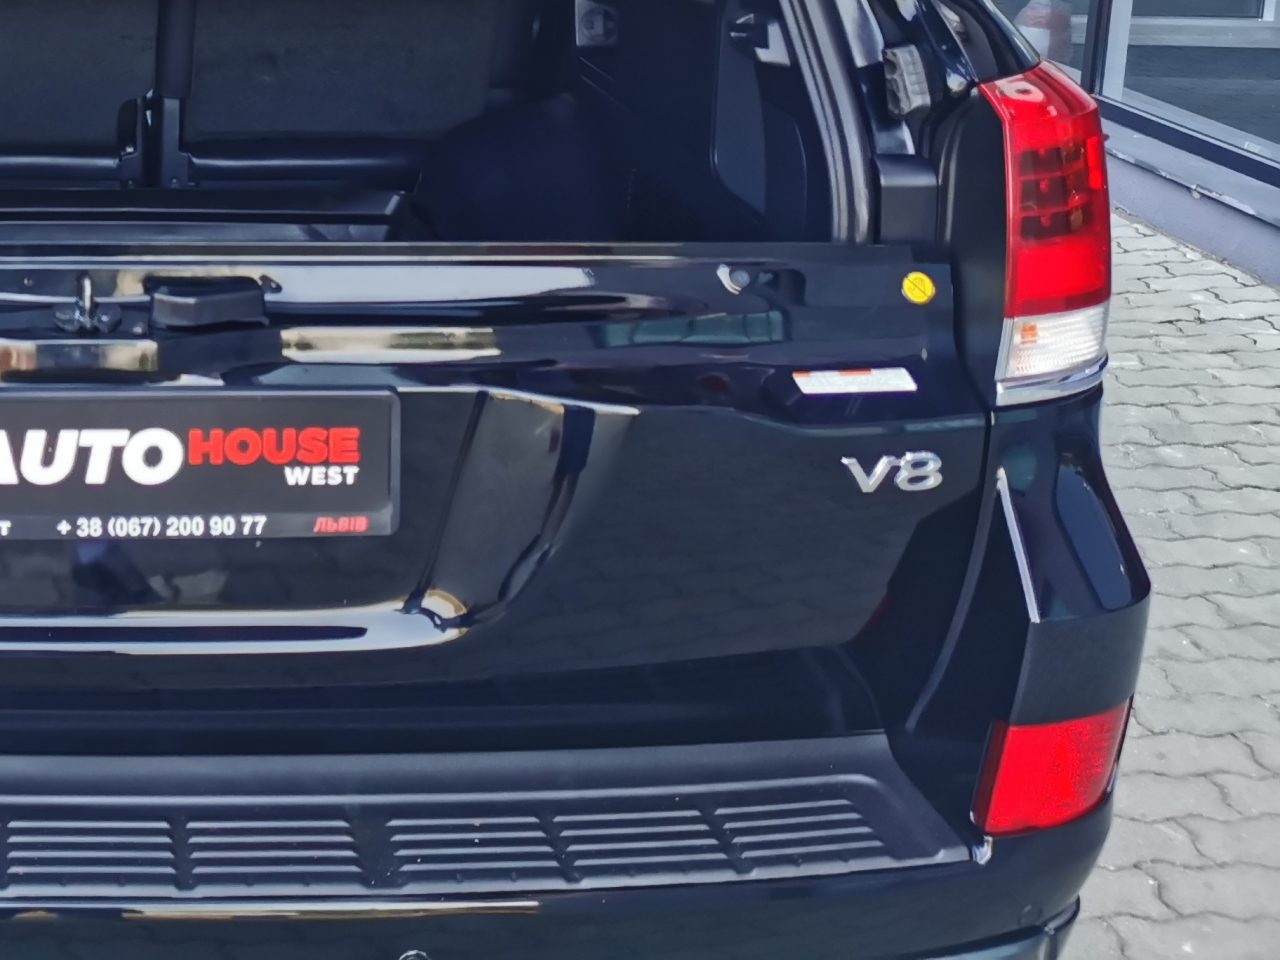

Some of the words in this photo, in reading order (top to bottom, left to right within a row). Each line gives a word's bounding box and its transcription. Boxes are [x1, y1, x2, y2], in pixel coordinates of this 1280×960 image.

[284, 465, 360, 486] WEST
[840, 451, 943, 493] V8
[76, 516, 103, 538] 38
[107, 515, 162, 537] (067)
[165, 515, 205, 537] 200
[209, 515, 236, 537] 90
[240, 514, 267, 536] 77
